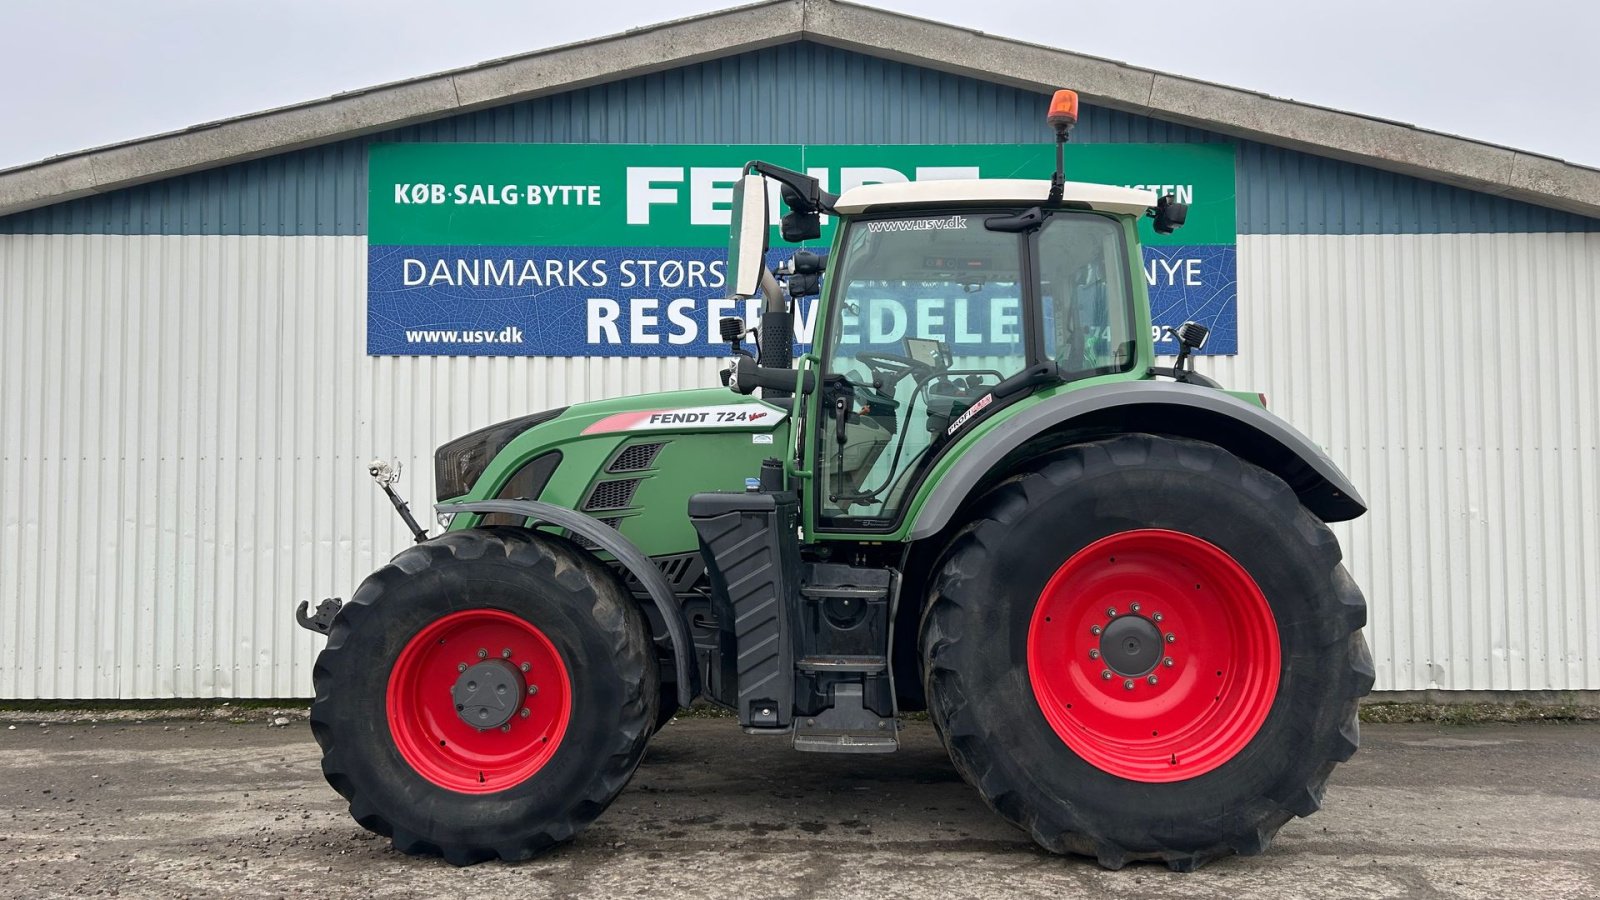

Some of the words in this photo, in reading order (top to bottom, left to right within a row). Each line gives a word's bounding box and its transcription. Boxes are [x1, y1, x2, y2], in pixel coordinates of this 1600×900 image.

[867, 216, 967, 232] www.usv.dk
[403, 259, 608, 287] DANMARKS
[620, 259, 729, 288] STØRS
[587, 298, 1020, 345] RESEVEDELE
[405, 326, 523, 343] www.usv.dk
[649, 412, 709, 424] FENDT
[716, 411, 747, 422] 724
